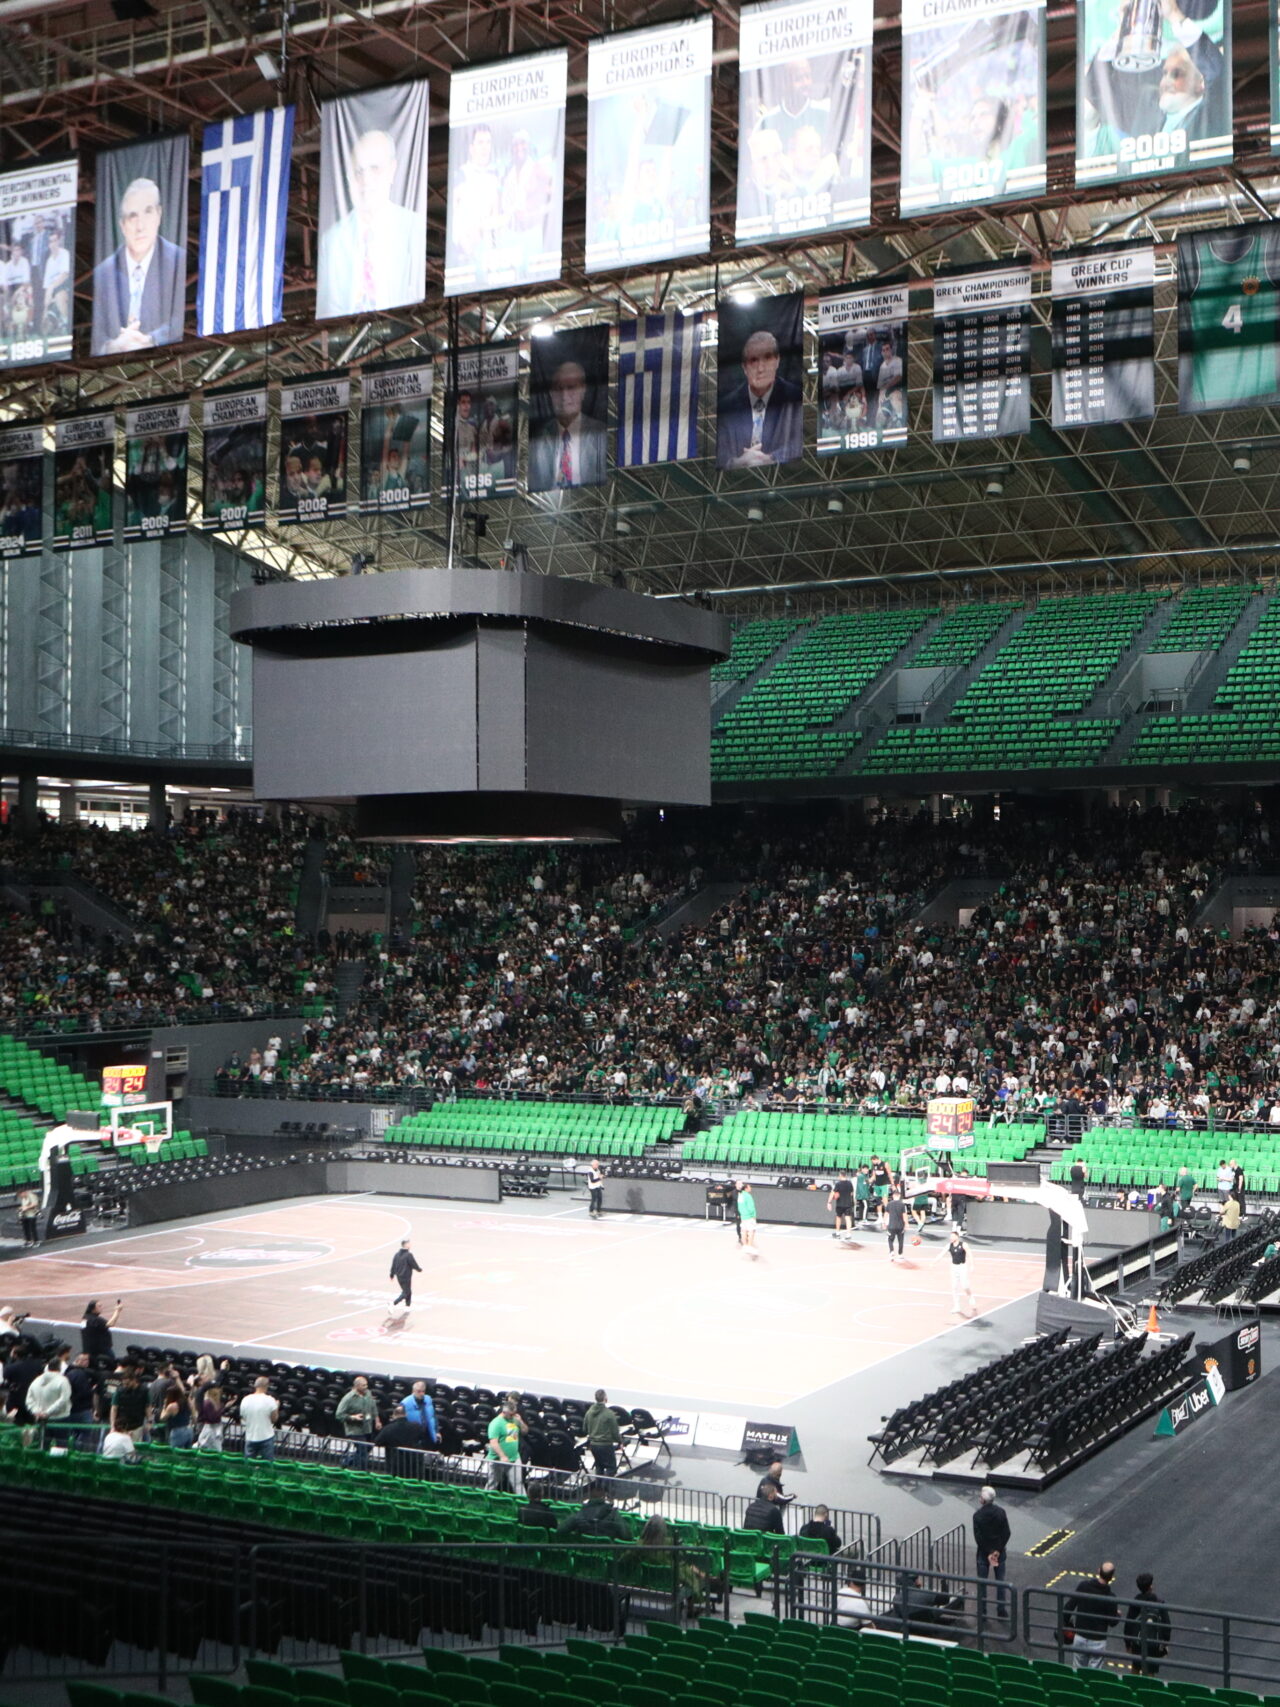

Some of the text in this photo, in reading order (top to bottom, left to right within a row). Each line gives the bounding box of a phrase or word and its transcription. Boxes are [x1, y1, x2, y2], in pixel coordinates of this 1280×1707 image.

[765, 6, 848, 37] EUROPEAN
[758, 22, 853, 55] CHAMPIONS
[611, 38, 690, 67] EUROPEAN
[606, 53, 695, 85] CHAMPIONS
[472, 70, 544, 96] EUROPEAN
[466, 85, 549, 113] CHAMPIONS
[1120, 128, 1187, 162] 2009
[943, 160, 1003, 191] 2007
[0, 173, 72, 196] TERCONTINENTAL
[775, 192, 831, 223] 2002
[1072, 258, 1133, 277] GREEK CUP
[936, 277, 1030, 297] GREEK CHAMPIONSHIP
[1076, 272, 1129, 289] WINNERS
[822, 292, 904, 315] INTERCONTINENTAL
[963, 290, 1002, 303] WINNERS
[832, 306, 893, 324] CUP WINNERS
[1222, 304, 1243, 334] 4
[964, 329, 977, 337] 1973
[1089, 322, 1104, 330] 2013
[983, 337, 999, 345] 2003
[1089, 344, 1104, 352] 2015
[11, 339, 44, 361] 1996
[983, 347, 999, 355] 2004
[374, 374, 419, 389] EUROPEAN
[983, 380, 999, 388] 2007
[294, 386, 337, 401] EUROPEAN
[370, 384, 422, 401] CHAMPIONS
[215, 396, 256, 412] EUROPEAN
[290, 397, 340, 412] CHAMPIONS
[1065, 403, 1082, 411] 2007
[138, 408, 178, 422] EUROPEAN
[212, 406, 259, 423] CHAMPIONS
[66, 420, 104, 434] EUROPEAN
[135, 418, 180, 433] CHAMPIONS
[844, 430, 878, 449] 1996
[464, 473, 493, 490] 1996
[379, 488, 410, 504] 2000
[298, 497, 328, 513] 2002
[141, 515, 169, 530] 2009
[220, 506, 247, 522] 2007
[72, 526, 93, 539] 2011
[104, 1078, 120, 1091] 24
[124, 1076, 144, 1092] 24
[930, 1114, 954, 1133] 24
[958, 1114, 972, 1133] 24
[1188, 1389, 1210, 1413] Uber
[746, 1430, 788, 1442] MATRIX
